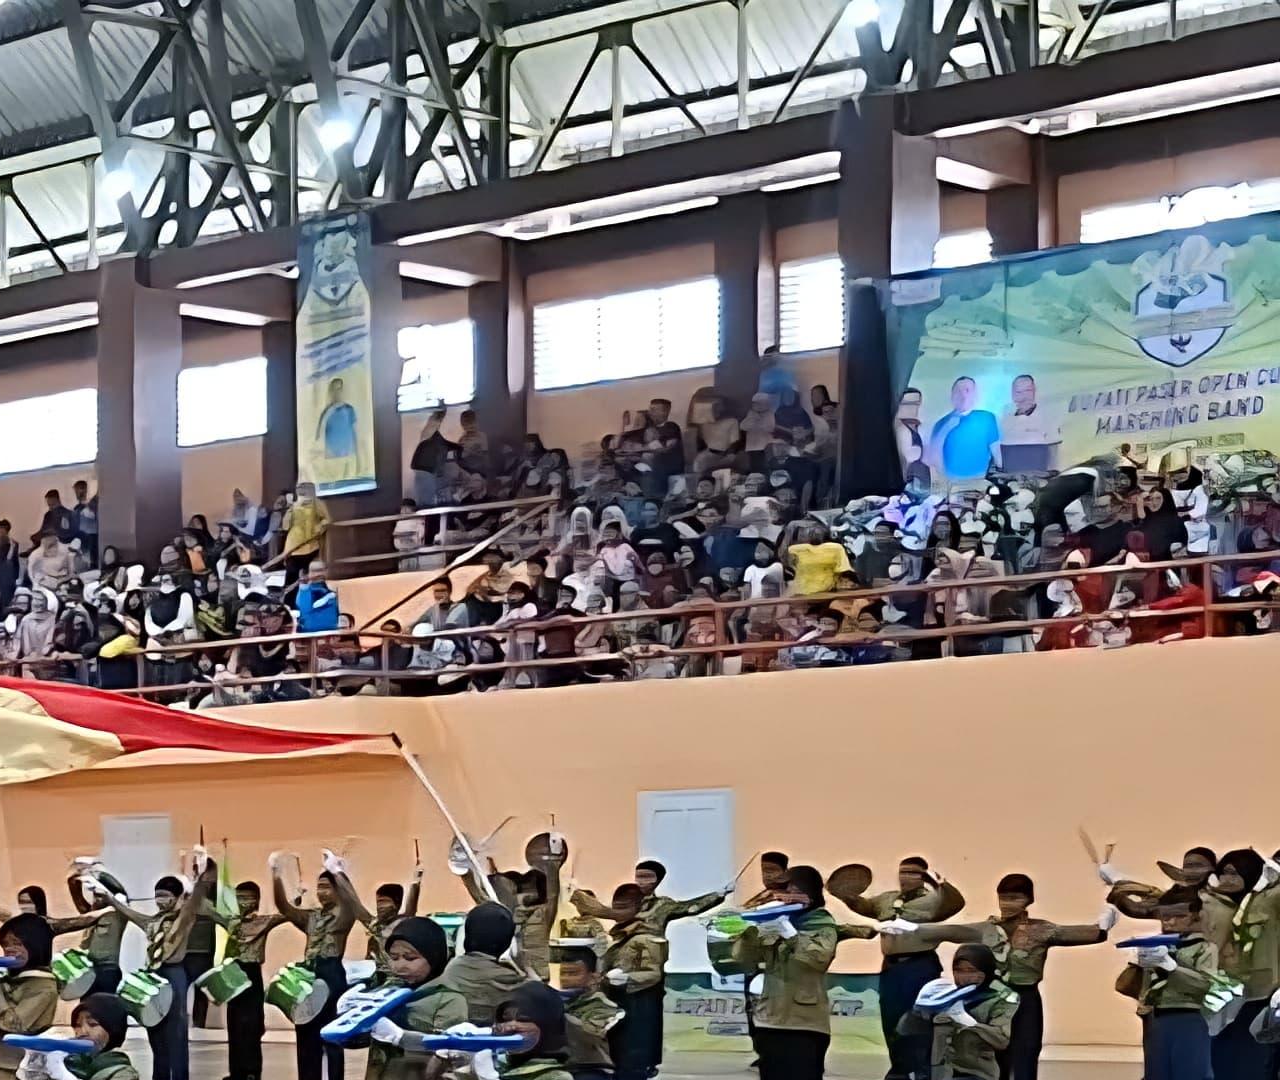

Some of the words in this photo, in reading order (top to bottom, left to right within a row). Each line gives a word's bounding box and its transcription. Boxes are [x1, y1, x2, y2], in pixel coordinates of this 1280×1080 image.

[1198, 372, 1249, 394] OPEN
[1257, 367, 1280, 386] CU
[1096, 403, 1200, 434] MARCHING
[1207, 395, 1265, 420] BAND
